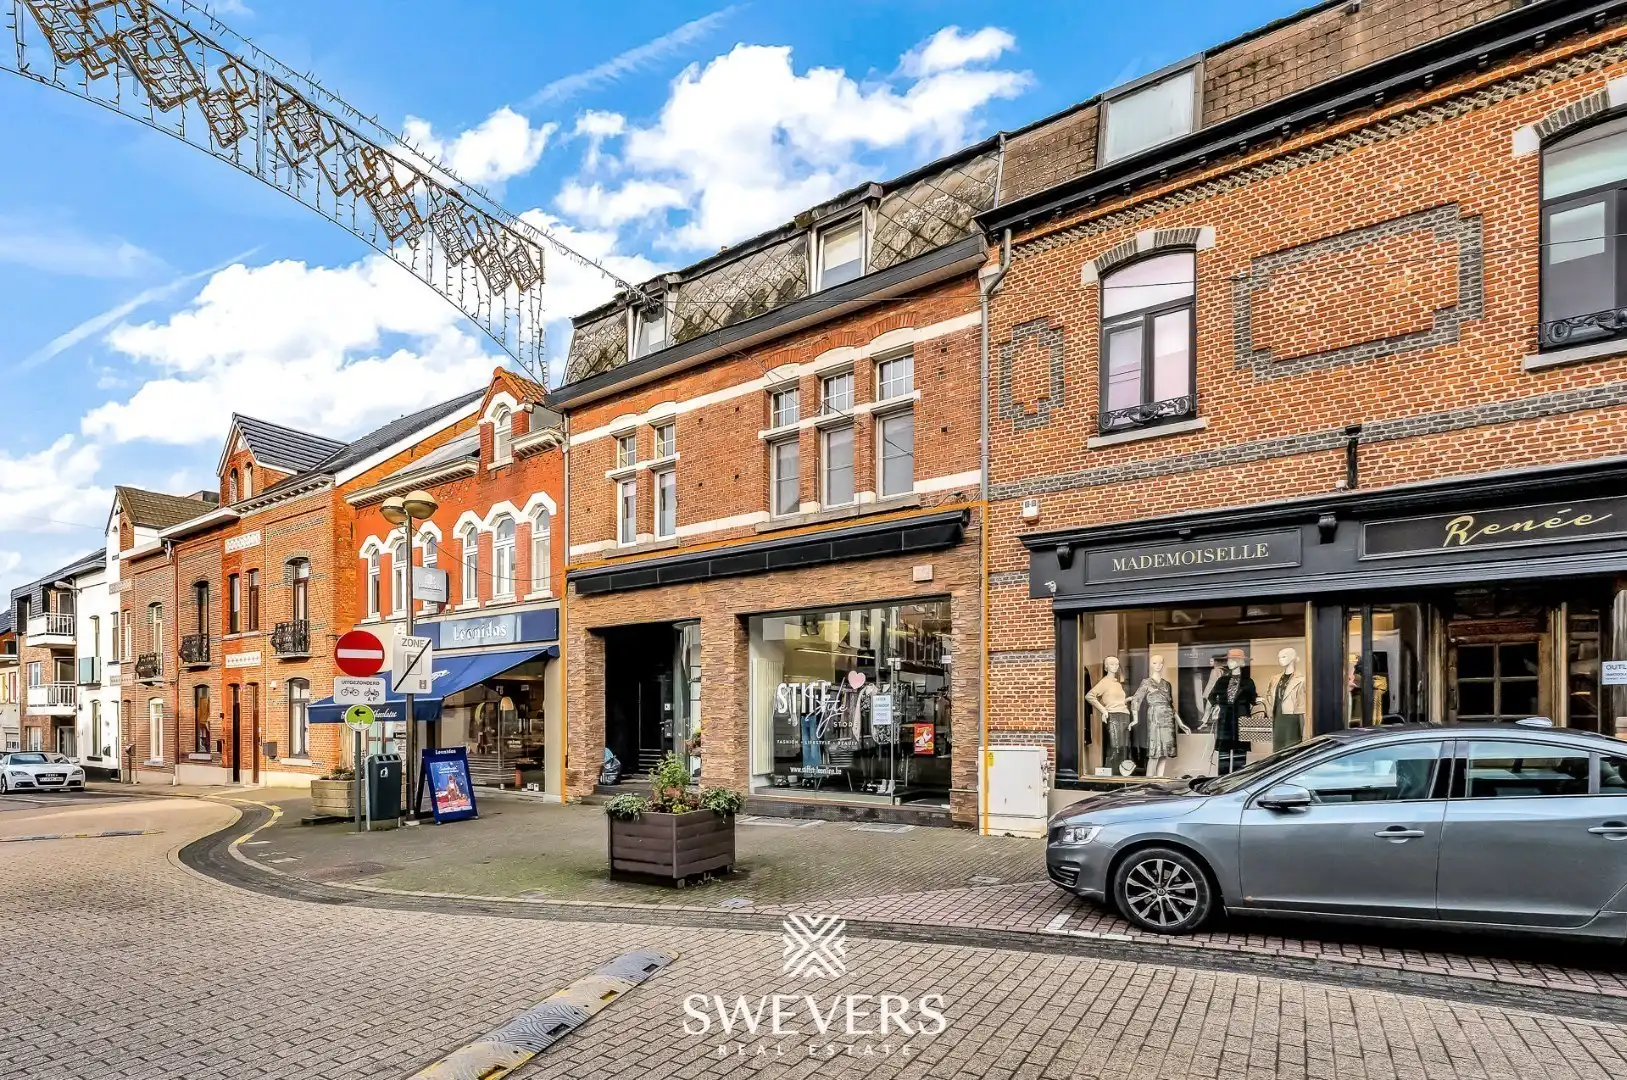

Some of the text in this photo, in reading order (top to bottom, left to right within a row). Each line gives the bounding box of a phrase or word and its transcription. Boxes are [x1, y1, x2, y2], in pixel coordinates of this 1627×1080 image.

[1442, 508, 1613, 548] Renée
[1112, 542, 1269, 572] MADEMOISELLE
[401, 638, 425, 648] ZONE
[453, 620, 508, 641] Leonidas
